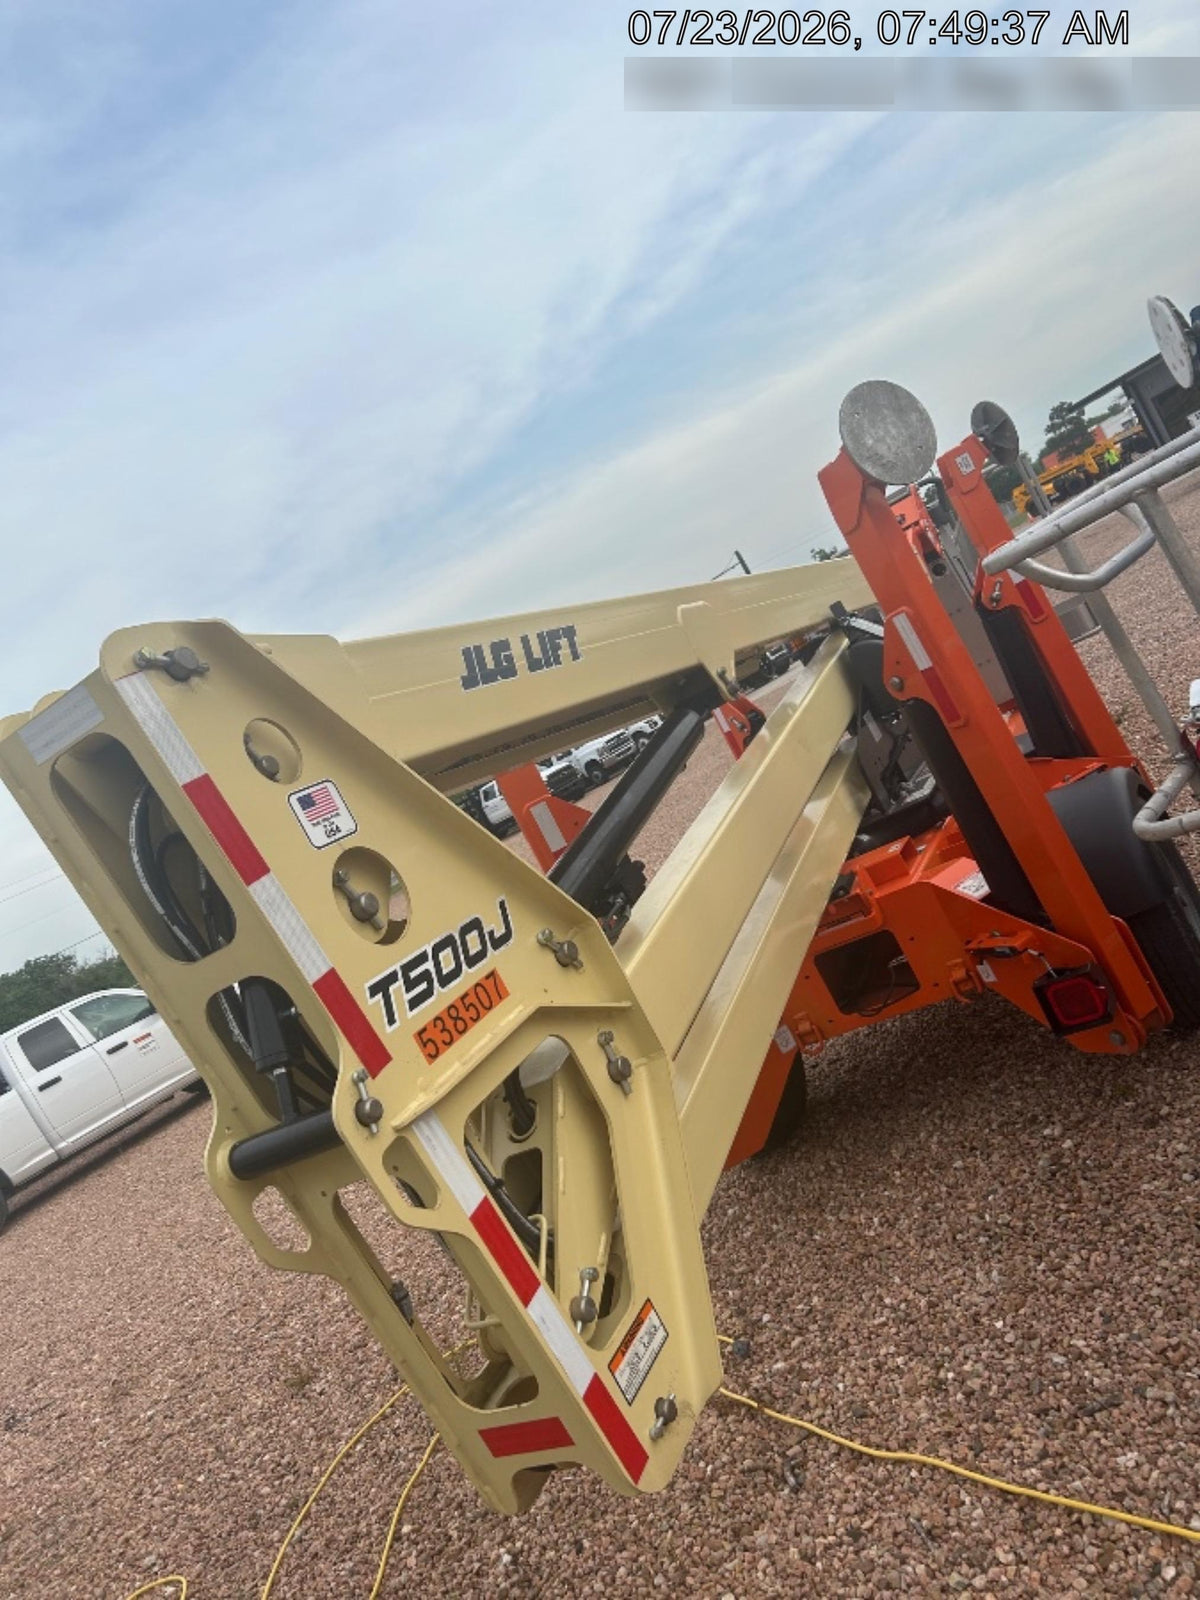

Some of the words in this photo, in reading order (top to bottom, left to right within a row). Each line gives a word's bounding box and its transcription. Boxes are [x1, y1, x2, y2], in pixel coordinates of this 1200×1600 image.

[460, 637, 520, 692] JLG
[520, 624, 583, 673] LIFT
[365, 897, 513, 1031] T500J
[416, 969, 505, 1061] 538507
